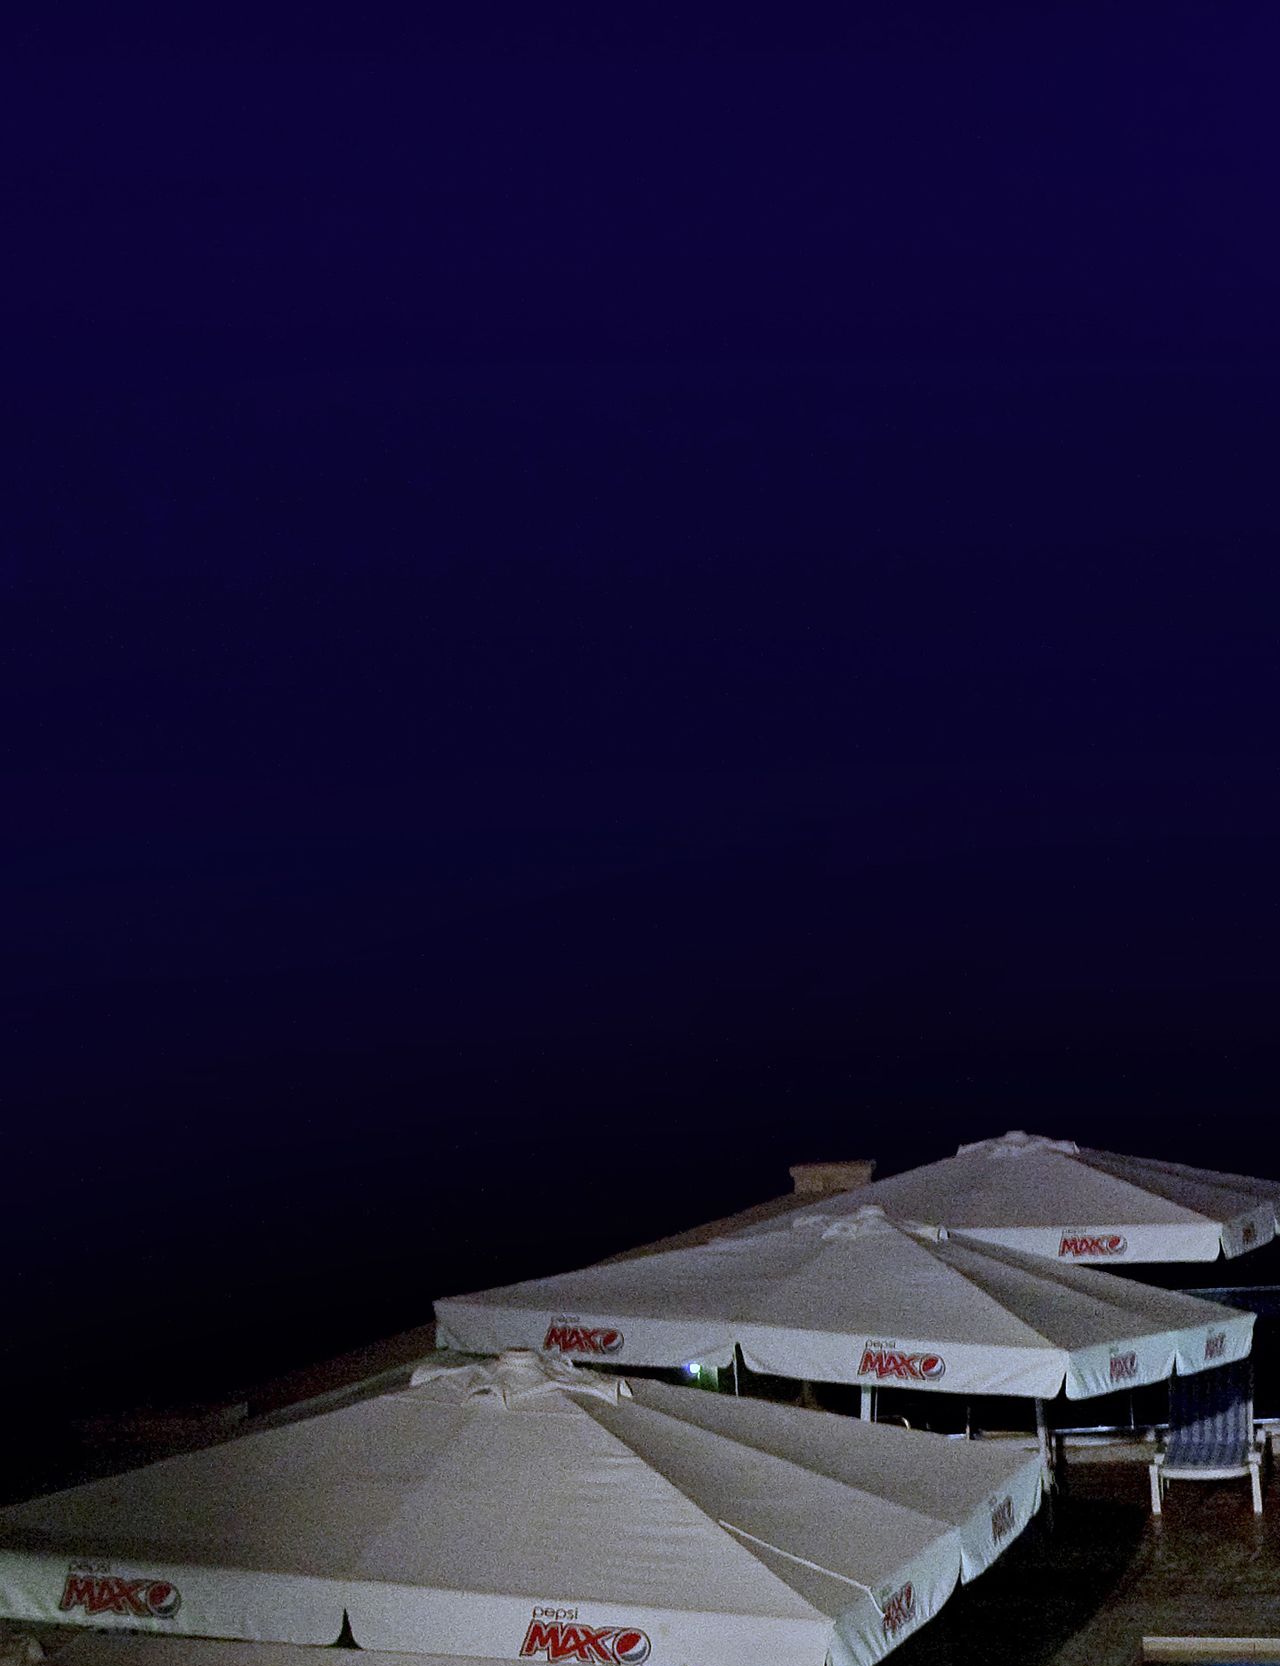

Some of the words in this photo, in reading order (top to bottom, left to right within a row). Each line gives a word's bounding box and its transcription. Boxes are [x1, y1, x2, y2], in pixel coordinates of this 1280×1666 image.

[1058, 1233, 1109, 1257] MAX
[542, 1322, 605, 1355] MAX
[857, 1347, 925, 1381] MAX
[58, 1573, 152, 1618] MAX
[532, 1605, 579, 1621] pepsi
[519, 1619, 621, 1665] MAX
